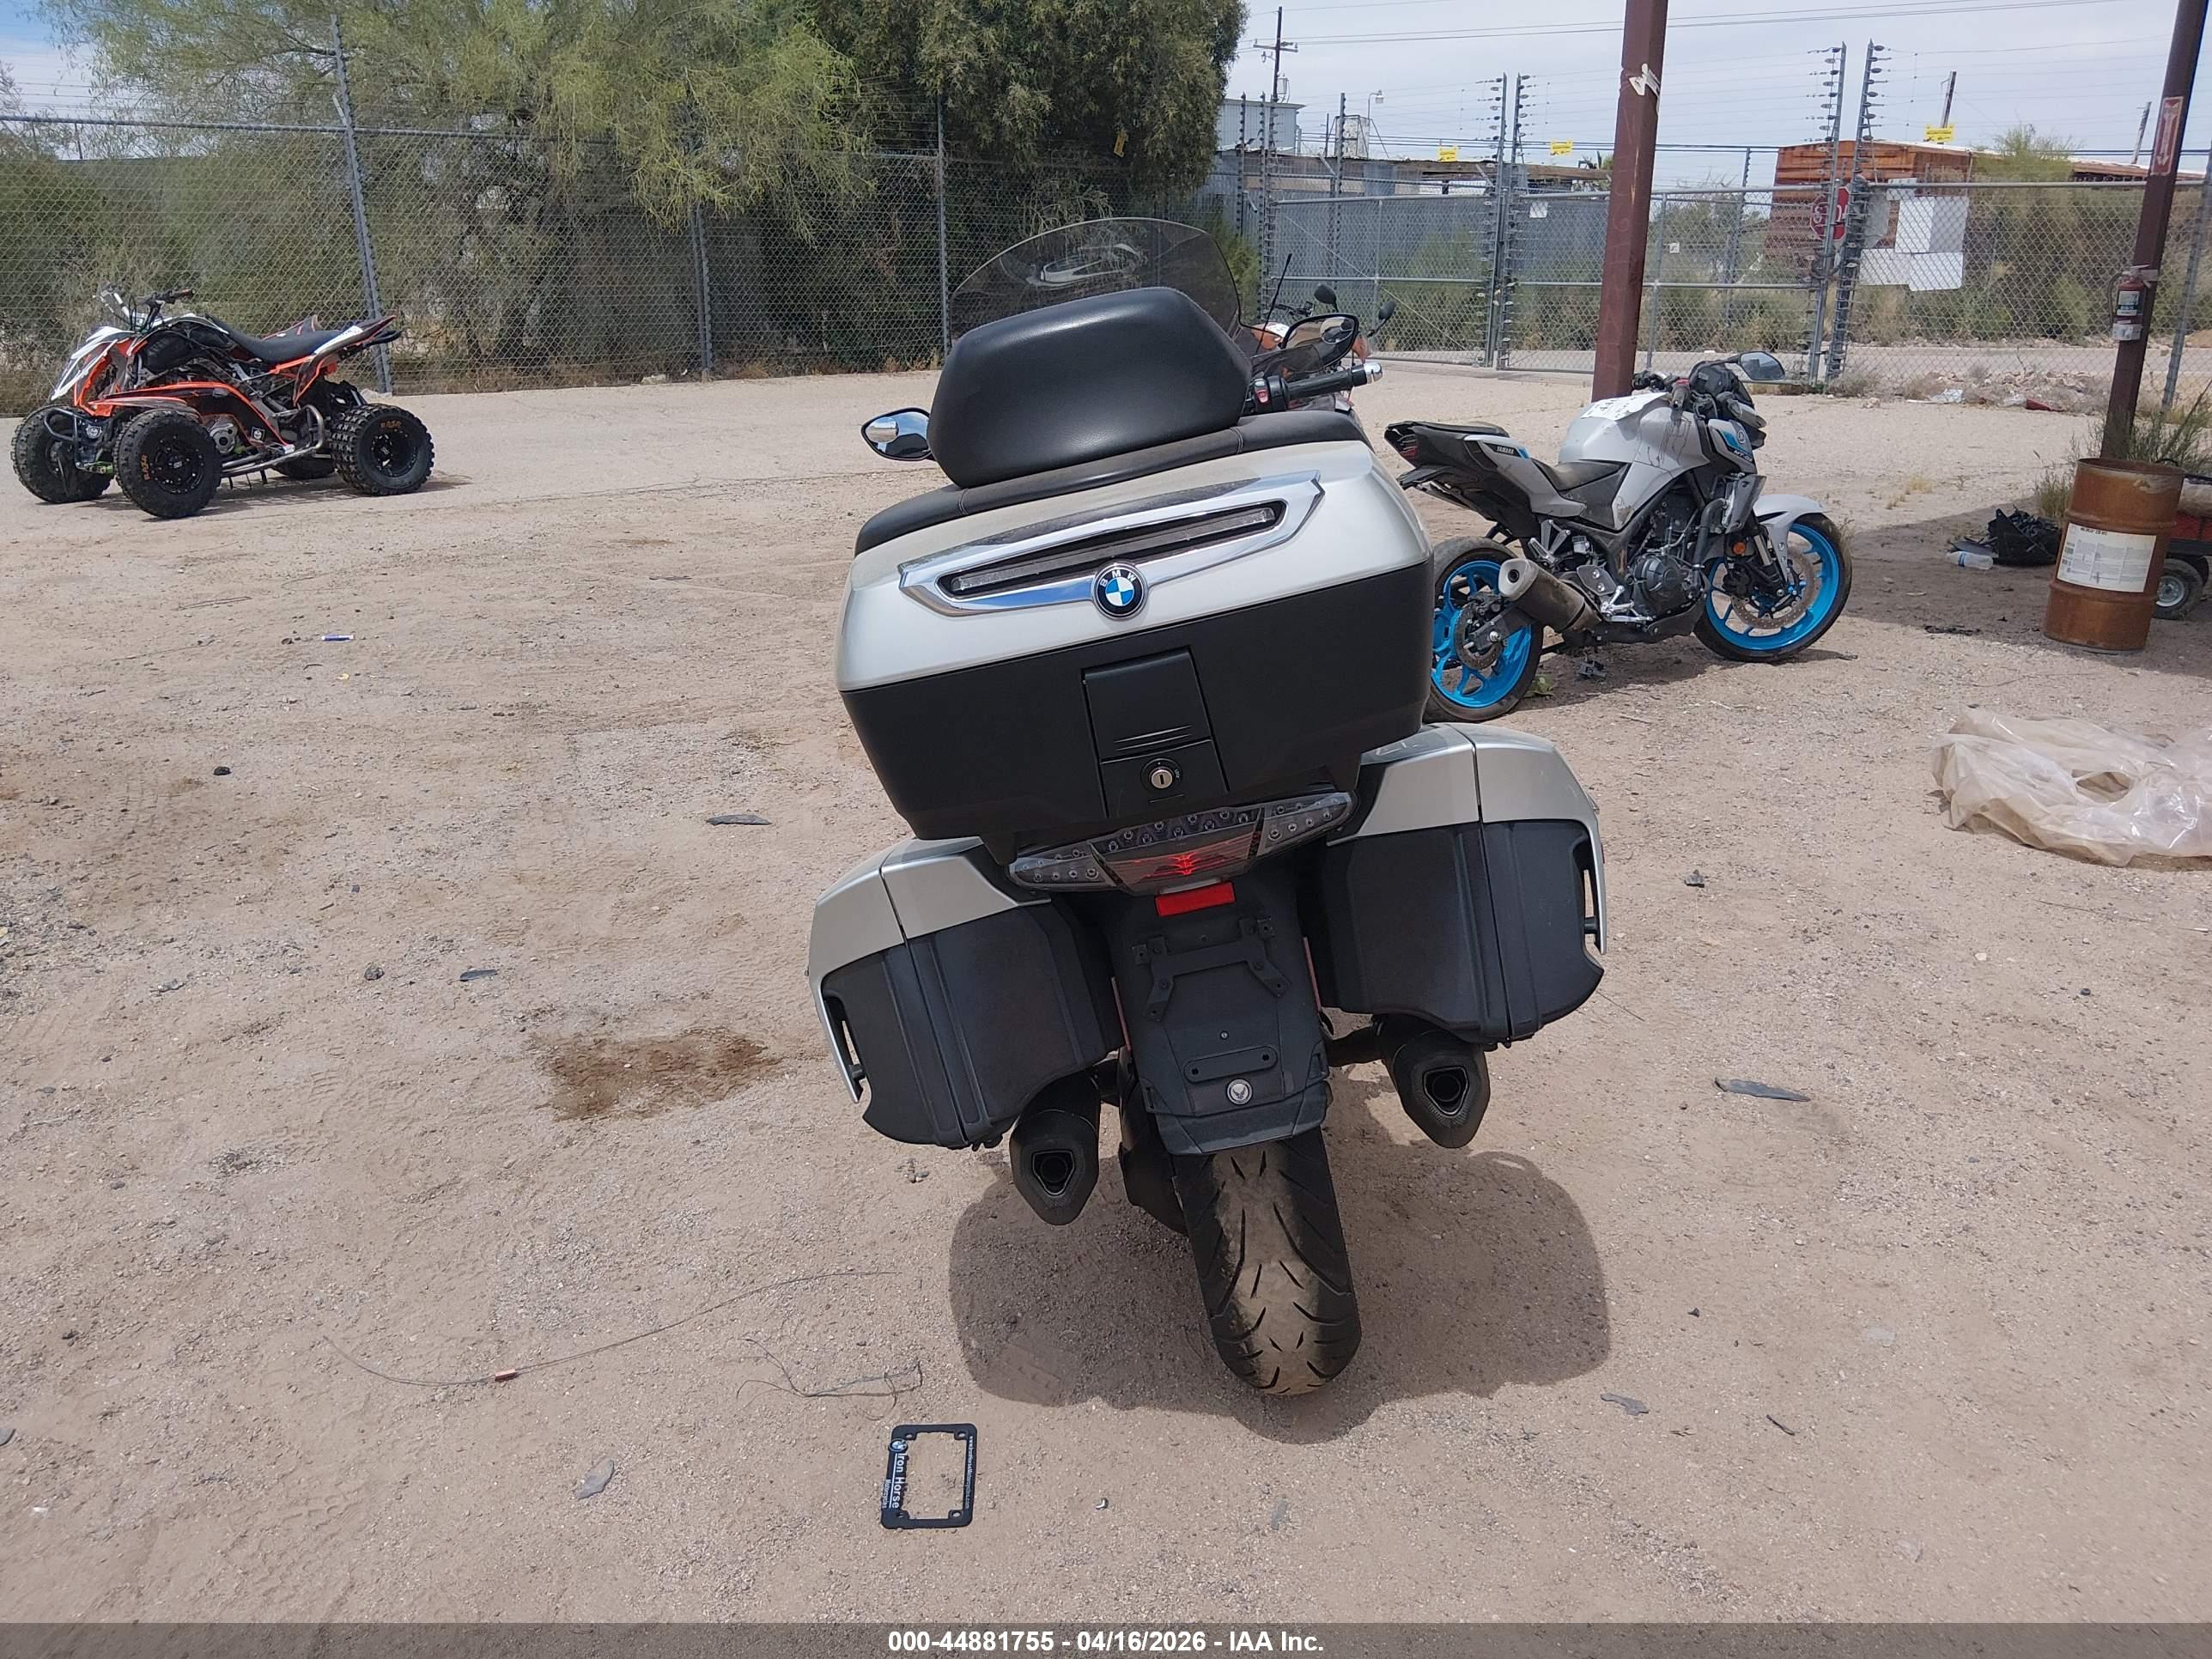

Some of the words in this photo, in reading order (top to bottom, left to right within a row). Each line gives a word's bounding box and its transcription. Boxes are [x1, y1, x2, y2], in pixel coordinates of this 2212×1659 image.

[1497, 446, 1515, 454] YAMAHA
[1100, 569, 1136, 587] BMW
[896, 1452, 908, 1473] Iron
[891, 1477, 906, 1509] Horse
